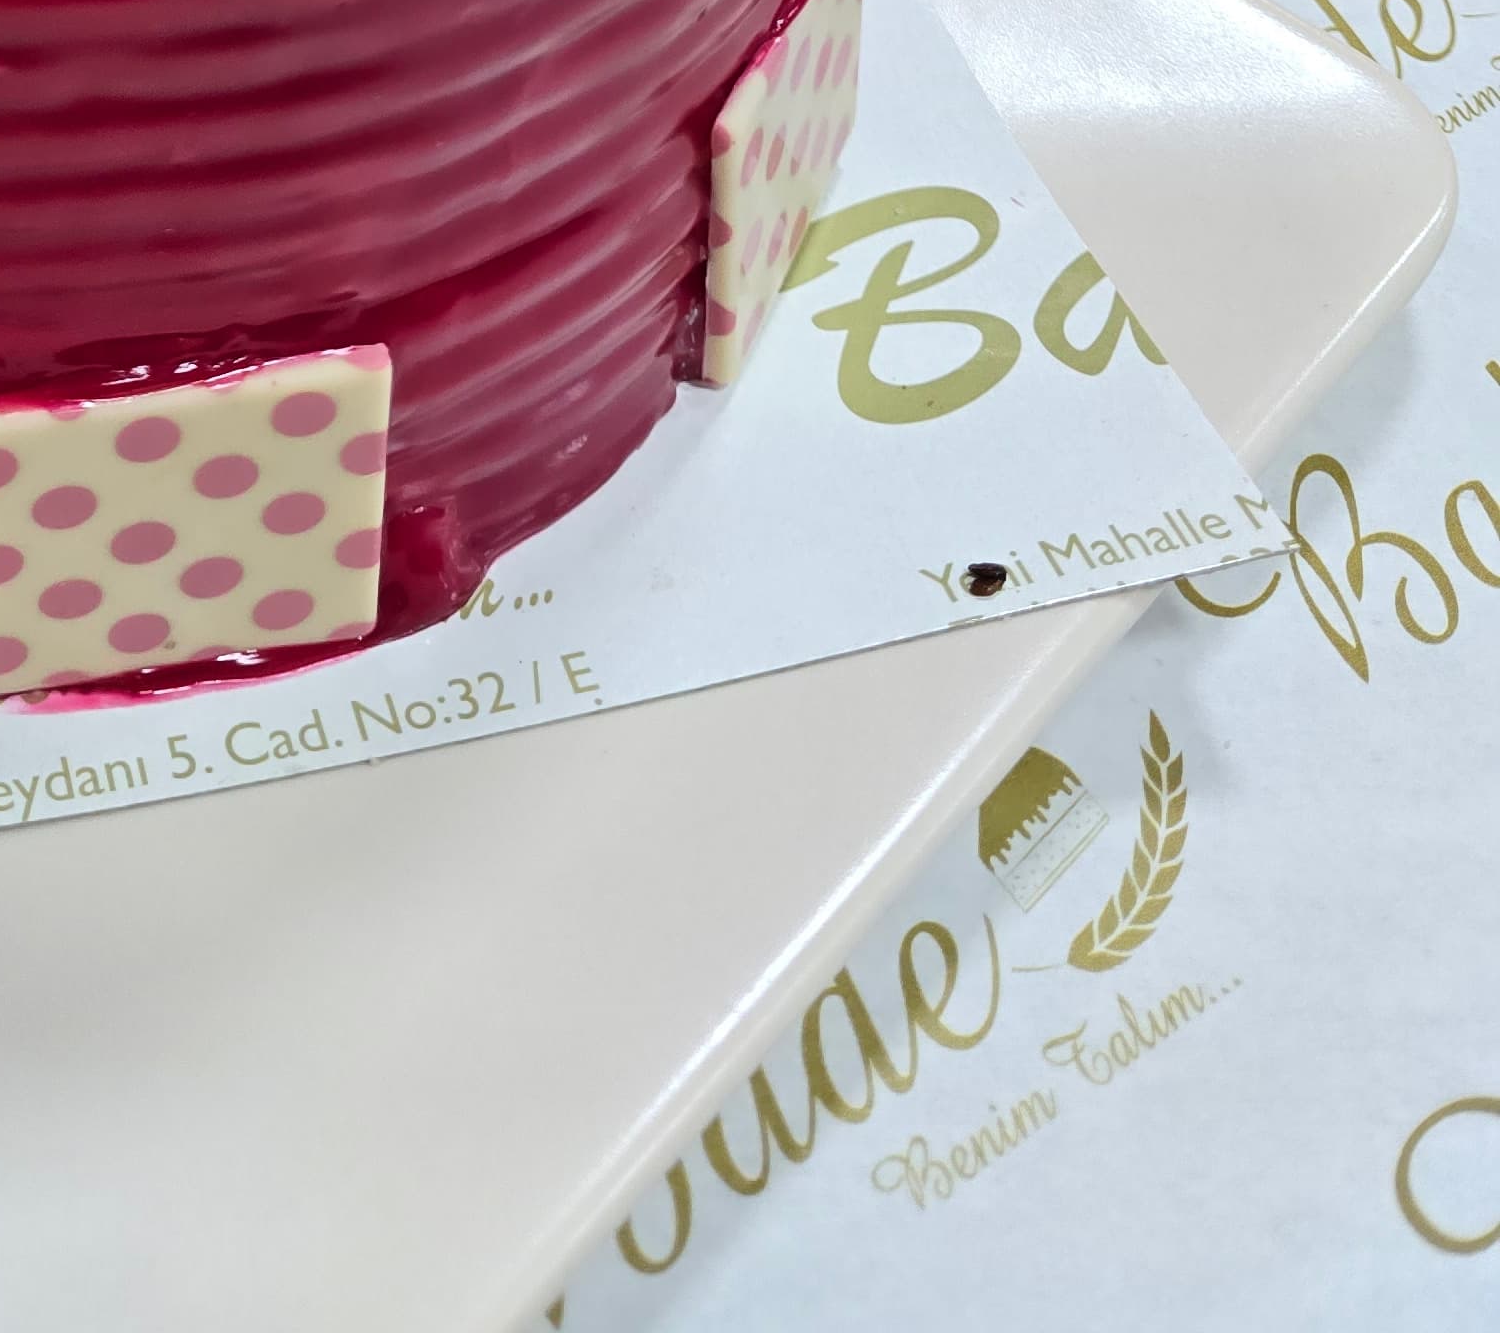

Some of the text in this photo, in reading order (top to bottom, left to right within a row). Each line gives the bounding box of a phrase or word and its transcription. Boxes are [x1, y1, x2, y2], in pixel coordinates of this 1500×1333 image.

[1435, 85, 1500, 134] enim
[779, 185, 1171, 425] Ba
[1038, 508, 1232, 577] Mahalle
[167, 734, 214, 780] 5.
[224, 708, 344, 767] Cad.
[350, 670, 516, 743] No:32
[871, 1089, 1058, 1211] Benim
